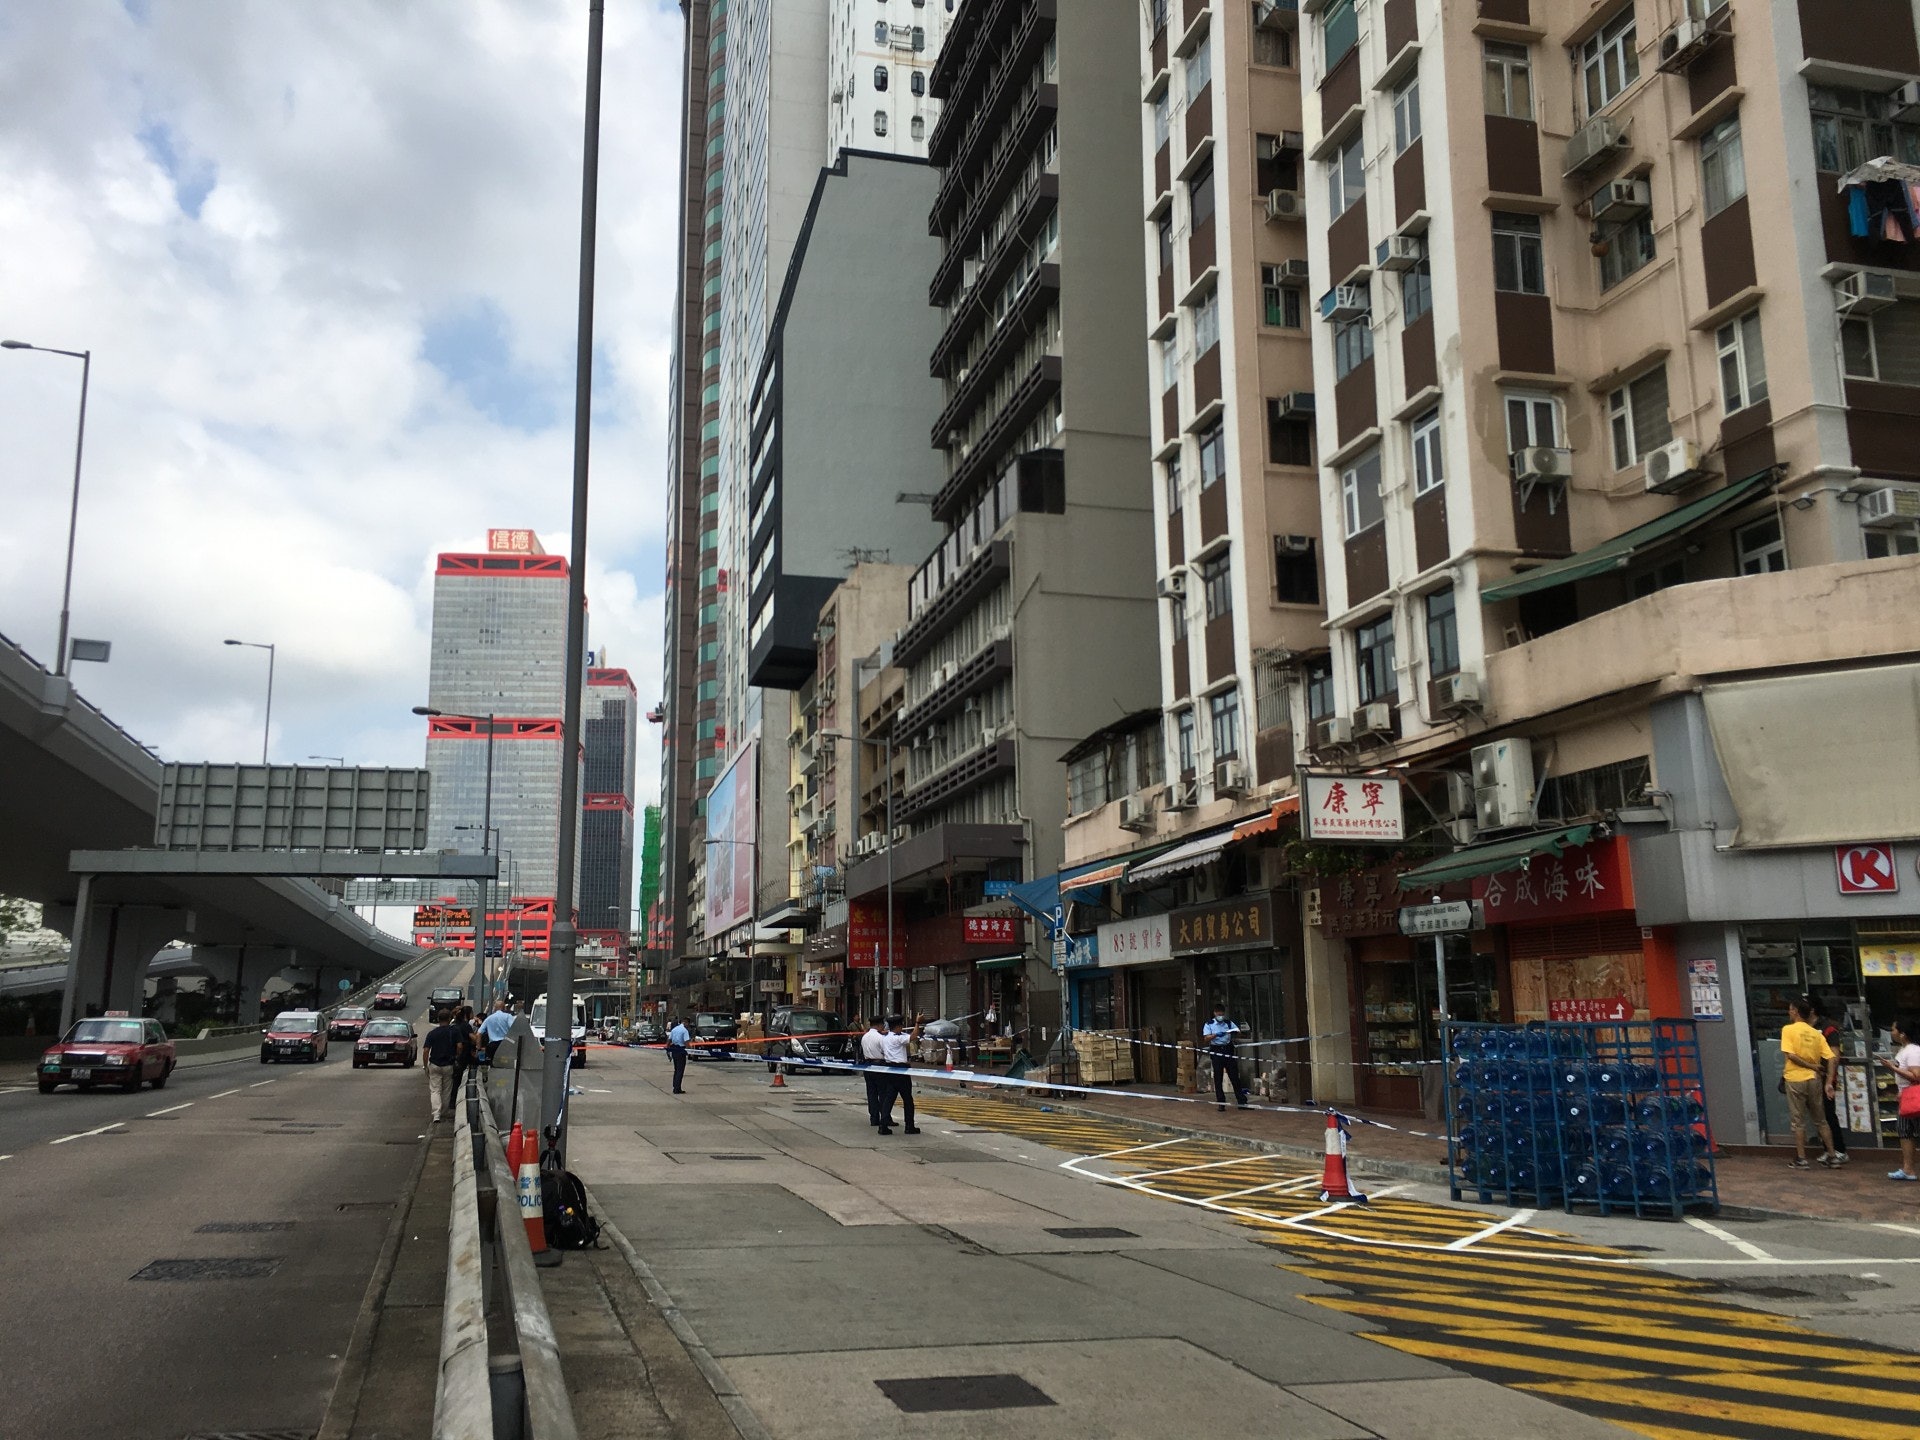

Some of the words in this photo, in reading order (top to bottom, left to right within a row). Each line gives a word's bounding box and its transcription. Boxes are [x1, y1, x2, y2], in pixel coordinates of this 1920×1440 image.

[491, 529, 530, 550] 信德
[1323, 782, 1385, 816] 康寧
[1484, 854, 1605, 907] 合成海味
[1055, 906, 1062, 927] P
[1178, 906, 1260, 944] 大同貿易公司
